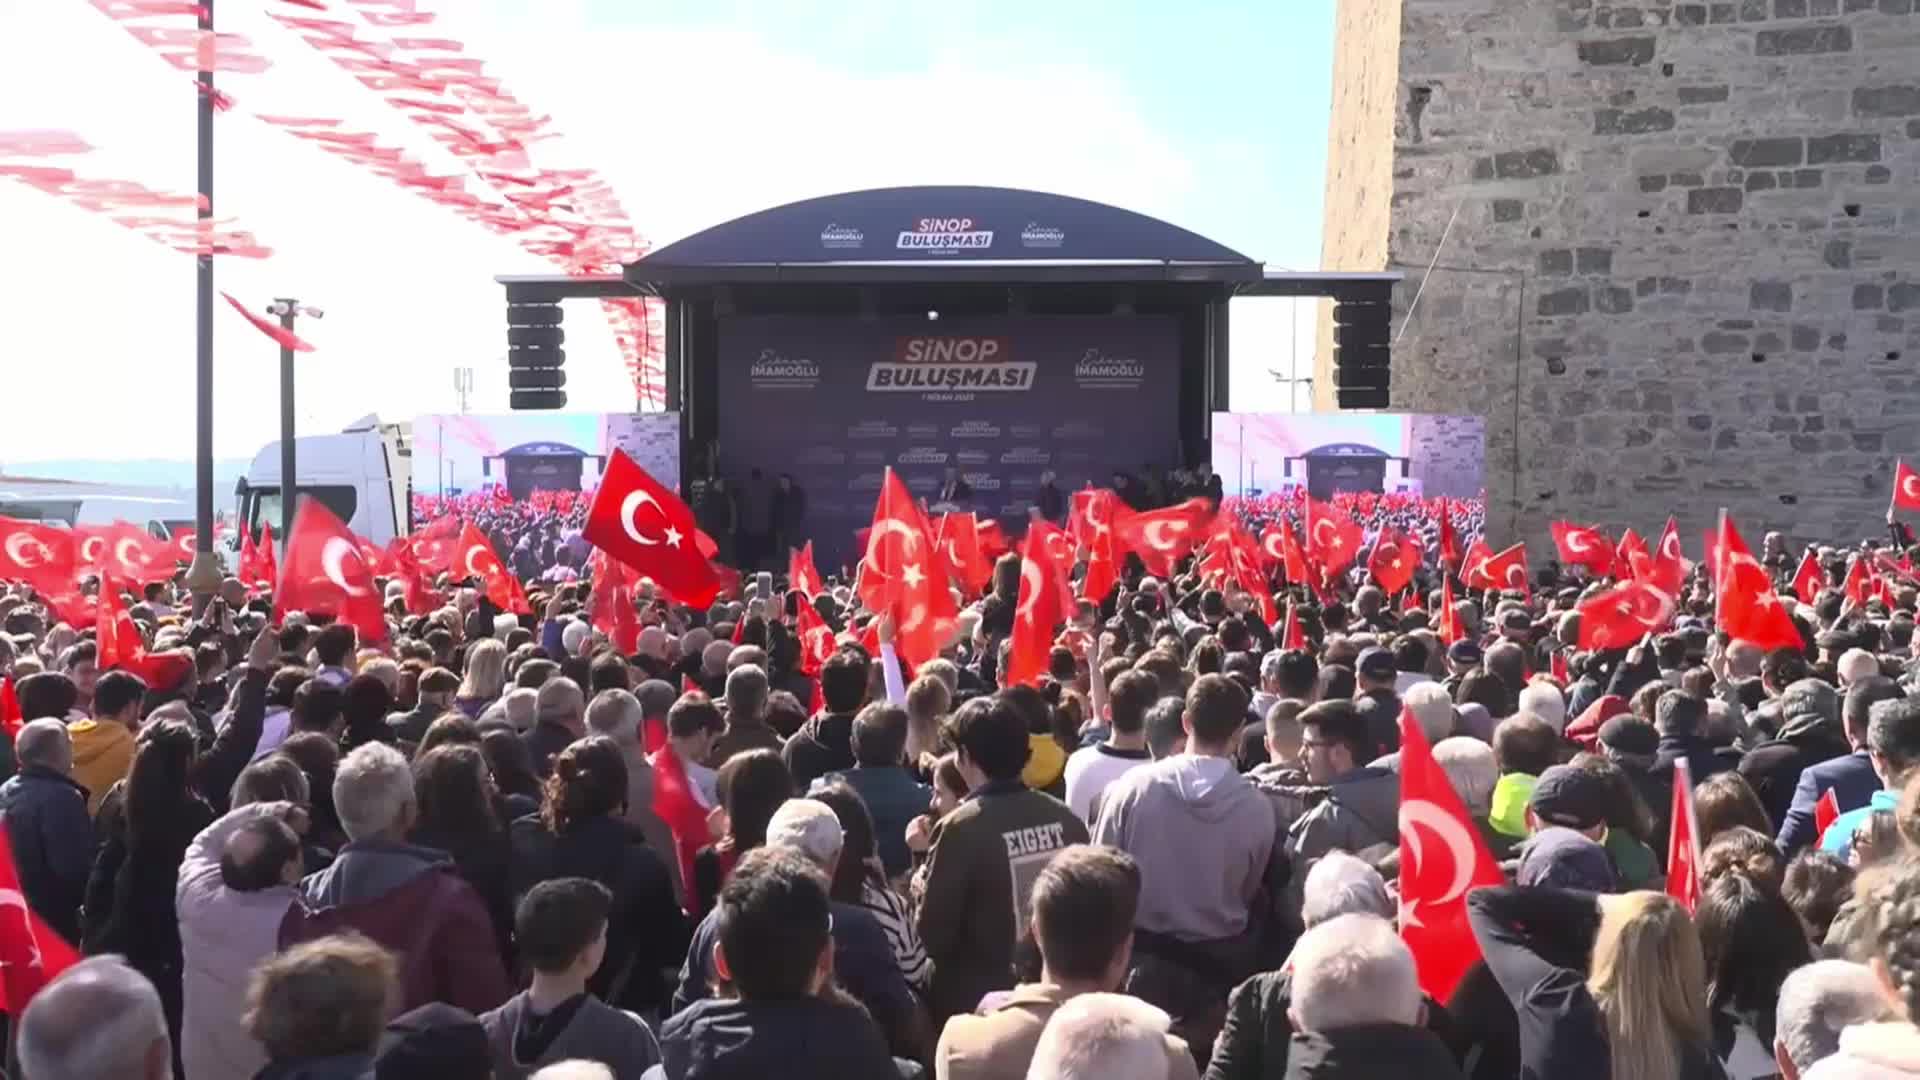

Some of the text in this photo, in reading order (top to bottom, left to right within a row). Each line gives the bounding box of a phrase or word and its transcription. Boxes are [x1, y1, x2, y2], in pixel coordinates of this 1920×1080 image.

[901, 234, 990, 249] BULUŞMASI
[873, 367, 1029, 391] BULUŞMASI
[1002, 822, 1064, 857] EIGHT
